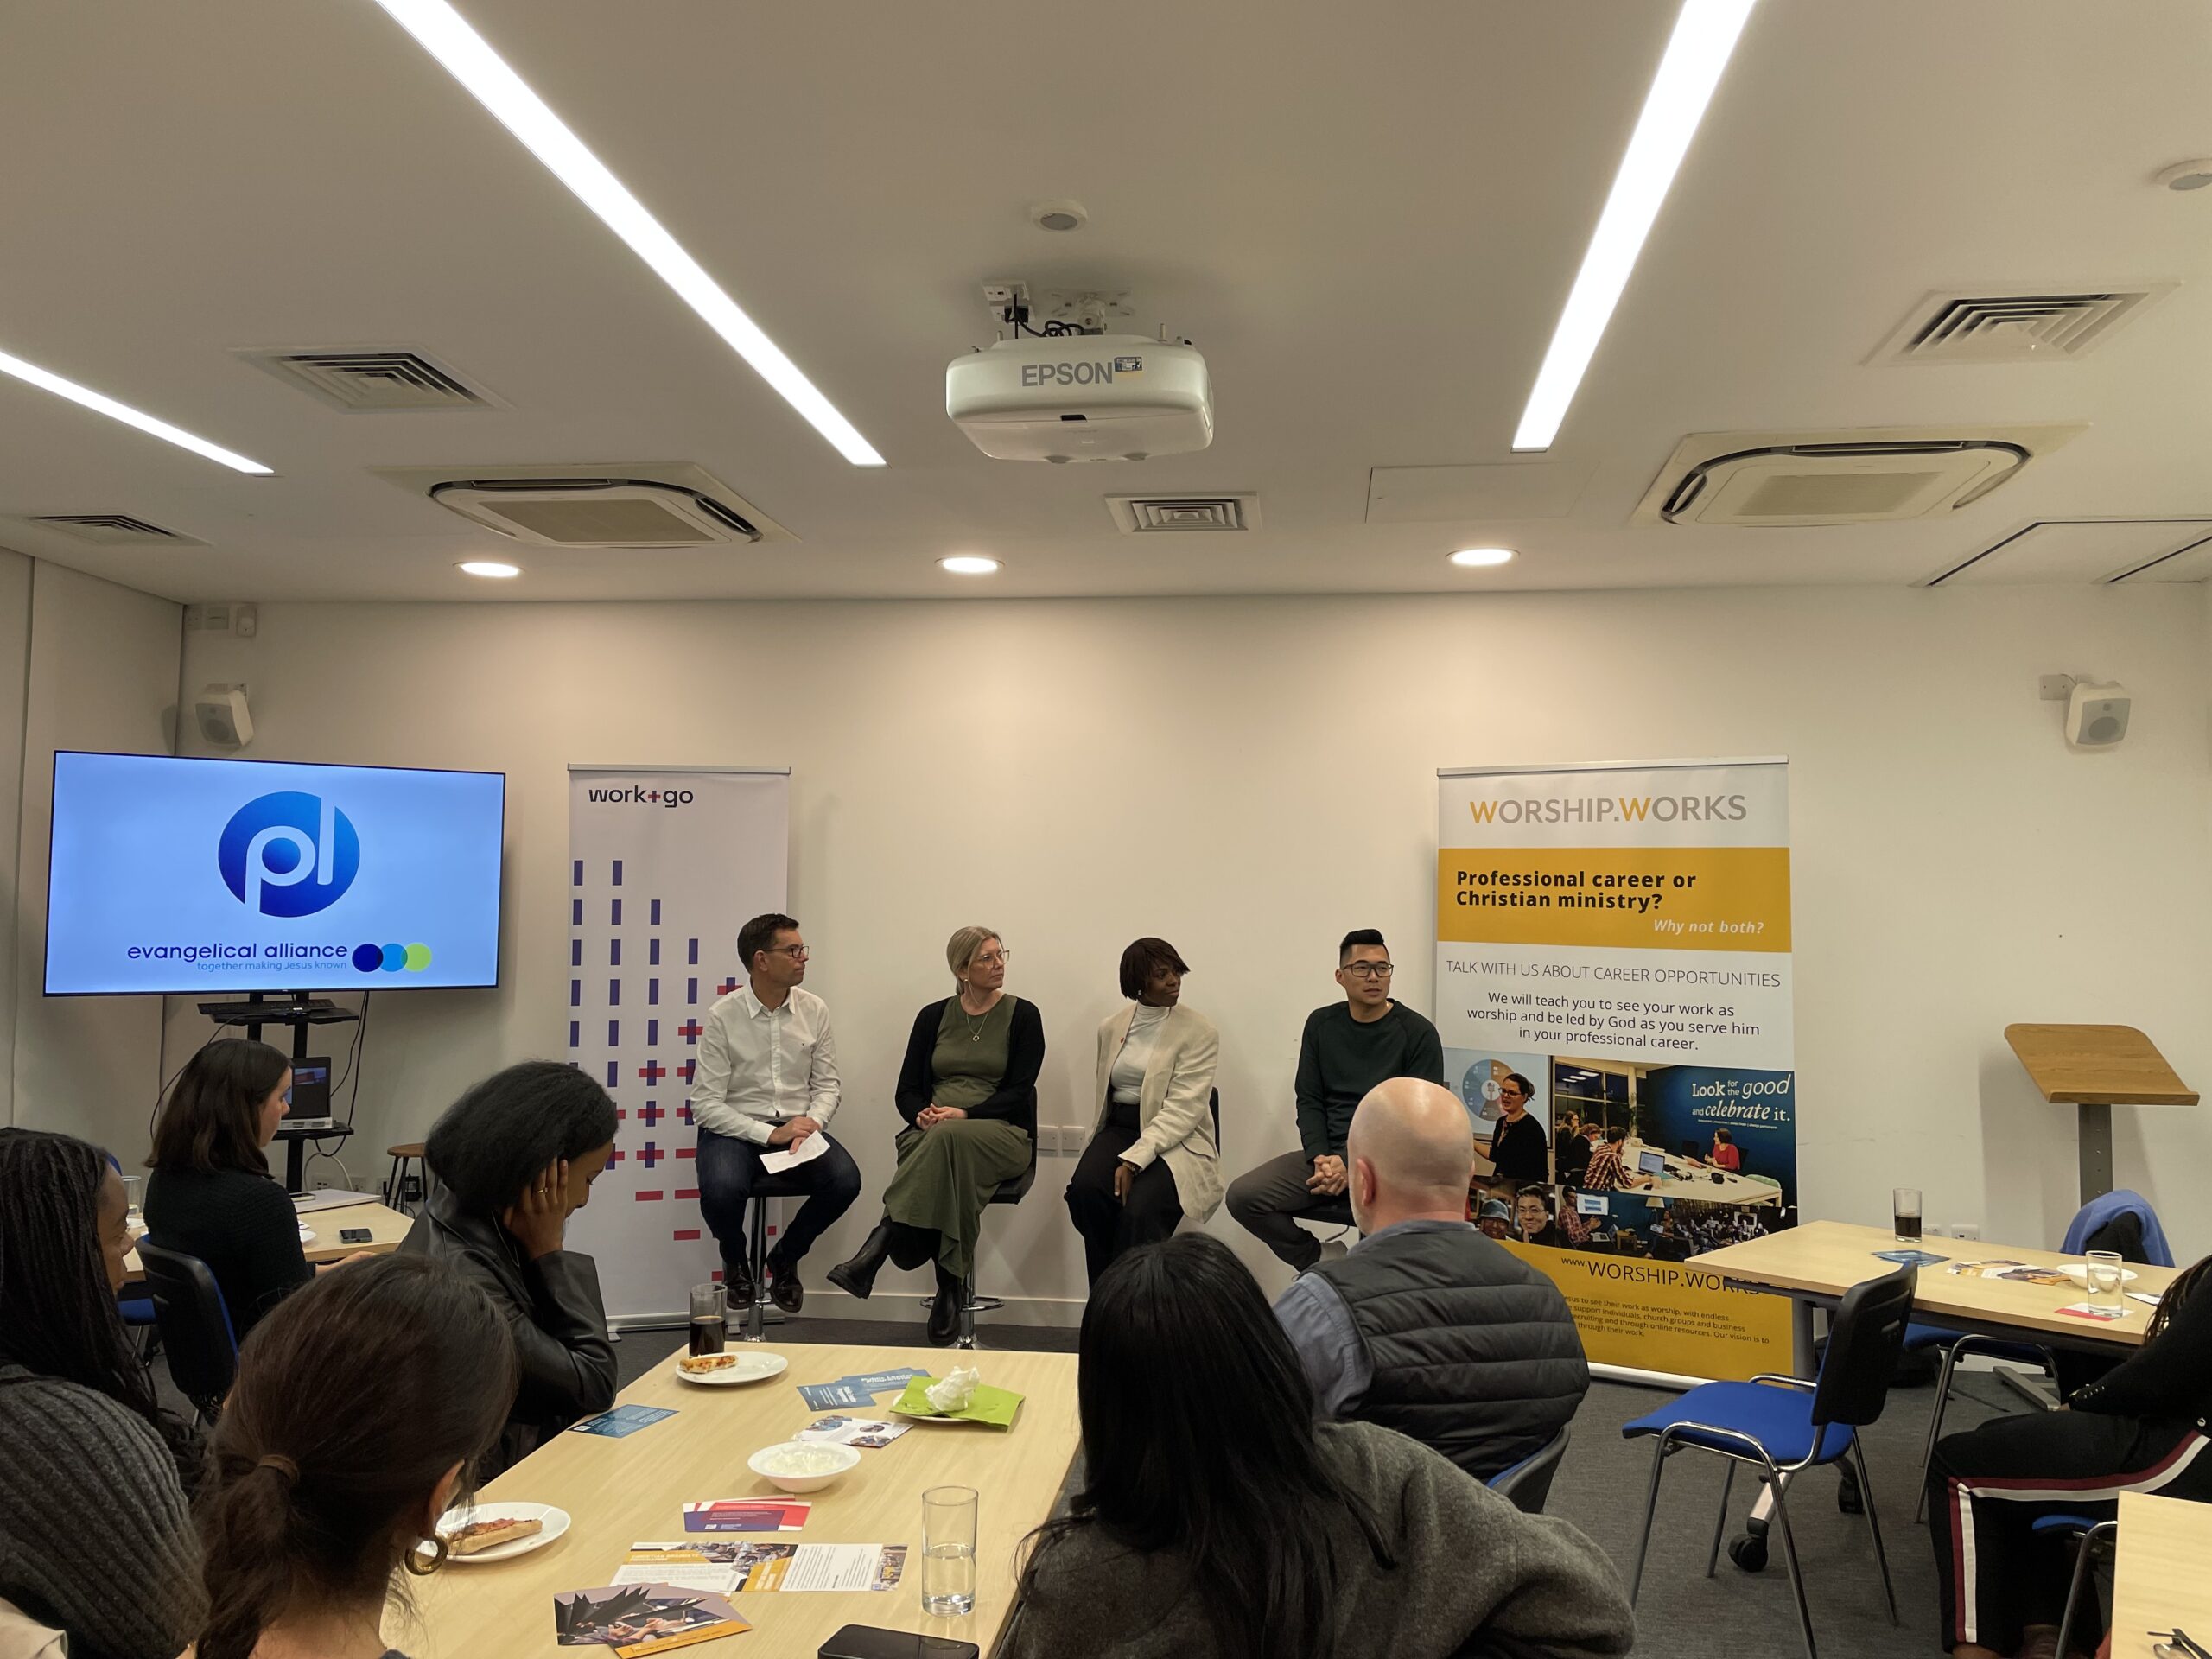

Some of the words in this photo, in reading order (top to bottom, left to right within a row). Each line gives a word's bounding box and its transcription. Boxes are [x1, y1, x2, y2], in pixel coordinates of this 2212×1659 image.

[1022, 362, 1112, 386] EPSON
[588, 785, 694, 808] work+go
[1470, 795, 1747, 823] WORSHIP.WORKS
[1457, 871, 1585, 887] Professional
[1592, 874, 1665, 887] career
[1673, 874, 1696, 887] or
[1457, 891, 1551, 907] Christian
[1558, 893, 1662, 913] ministry?
[1654, 919, 1684, 934] Why
[1689, 921, 1713, 933] not
[1719, 919, 1764, 934] both?
[128, 943, 257, 963] evangelical
[264, 943, 347, 959] alliance
[197, 961, 243, 972] together
[245, 961, 282, 972] making
[284, 960, 313, 971] Jesus
[315, 959, 346, 969] known
[1446, 961, 1478, 973] TALK
[1481, 962, 1516, 975] WITH
[1521, 963, 1539, 976] US
[1542, 964, 1590, 978] ABOUT
[1593, 967, 1649, 982] CAREER
[1655, 969, 1780, 987] OPPORTUNITIES
[1488, 992, 1508, 1003] We
[1511, 993, 1532, 1005] will
[1536, 994, 1568, 1007] teach
[1573, 998, 1595, 1010] you
[1599, 998, 1612, 1009] to
[1617, 1001, 1639, 1011] see
[1643, 1002, 1675, 1015] your
[1679, 1002, 1713, 1015] work
[1719, 1007, 1734, 1016] as
[1467, 1007, 1516, 1022] worship
[1521, 1011, 1544, 1023] and
[1548, 1011, 1563, 1025] be
[1567, 1012, 1585, 1025] led
[1589, 1014, 1605, 1029] by
[1608, 1014, 1636, 1029] God
[1640, 1020, 1656, 1030] as
[1659, 1020, 1684, 1033] you
[1688, 1023, 1727, 1033] serve
[1732, 1021, 1759, 1035] him
[1519, 1027, 1530, 1038] in
[1534, 1029, 1561, 1042] your
[1566, 1029, 1646, 1046] professional
[1650, 1035, 1698, 1051] career.
[1693, 1081, 1726, 1096] Look
[1742, 1074, 1791, 1099] good
[1705, 1100, 1770, 1120] celebrate
[1774, 1108, 1790, 1121] it.
[1643, 1313, 1669, 1322] church
[1670, 1317, 1695, 1326] groups
[1697, 1319, 1712, 1328] and
[1713, 1322, 1745, 1332] business
[1701, 1313, 1729, 1321] endless
[1573, 1315, 1603, 1324] ecruiting
[1620, 1319, 1649, 1329] through
[1650, 1322, 1673, 1332] online
[1713, 1331, 1728, 1339] Our
[1730, 1332, 1751, 1342] vision
[1625, 1327, 1644, 1337] work.
